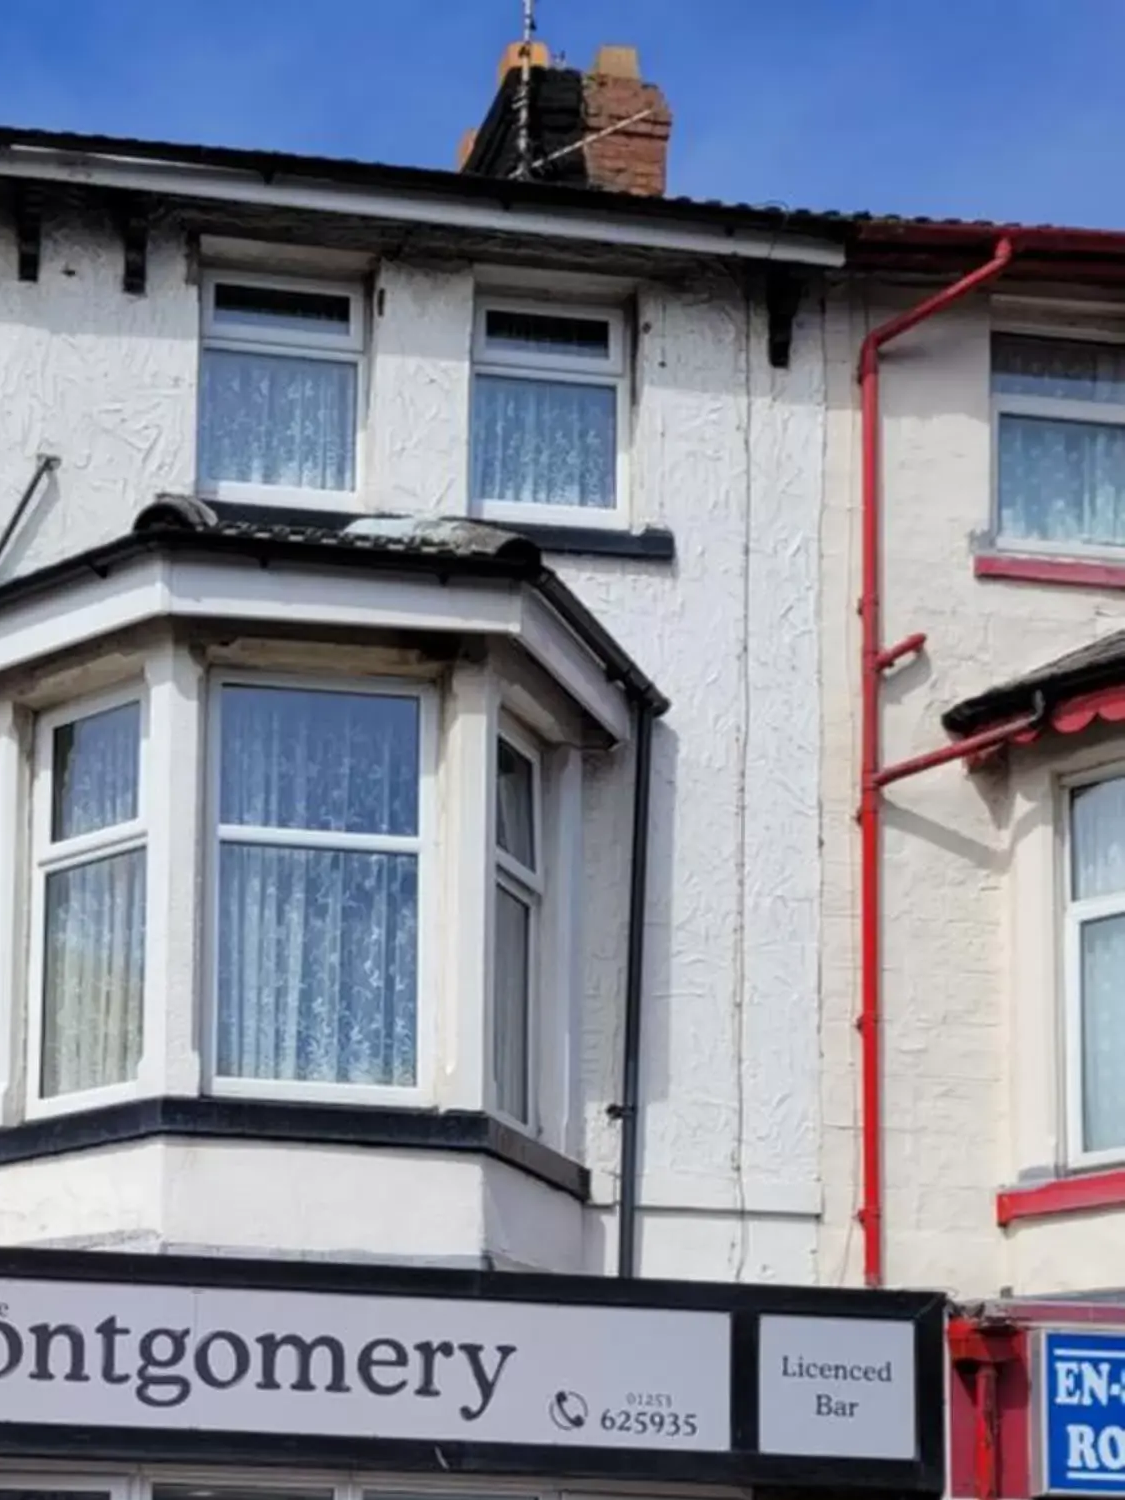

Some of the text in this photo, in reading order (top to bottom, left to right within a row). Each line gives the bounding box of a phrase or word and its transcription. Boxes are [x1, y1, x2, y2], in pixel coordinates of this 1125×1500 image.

[782, 1355, 892, 1382] Licenced
[1055, 1361, 1125, 1407] EN-
[626, 1392, 673, 1408] 01253
[816, 1394, 859, 1417] Bar
[600, 1408, 698, 1437] 625935
